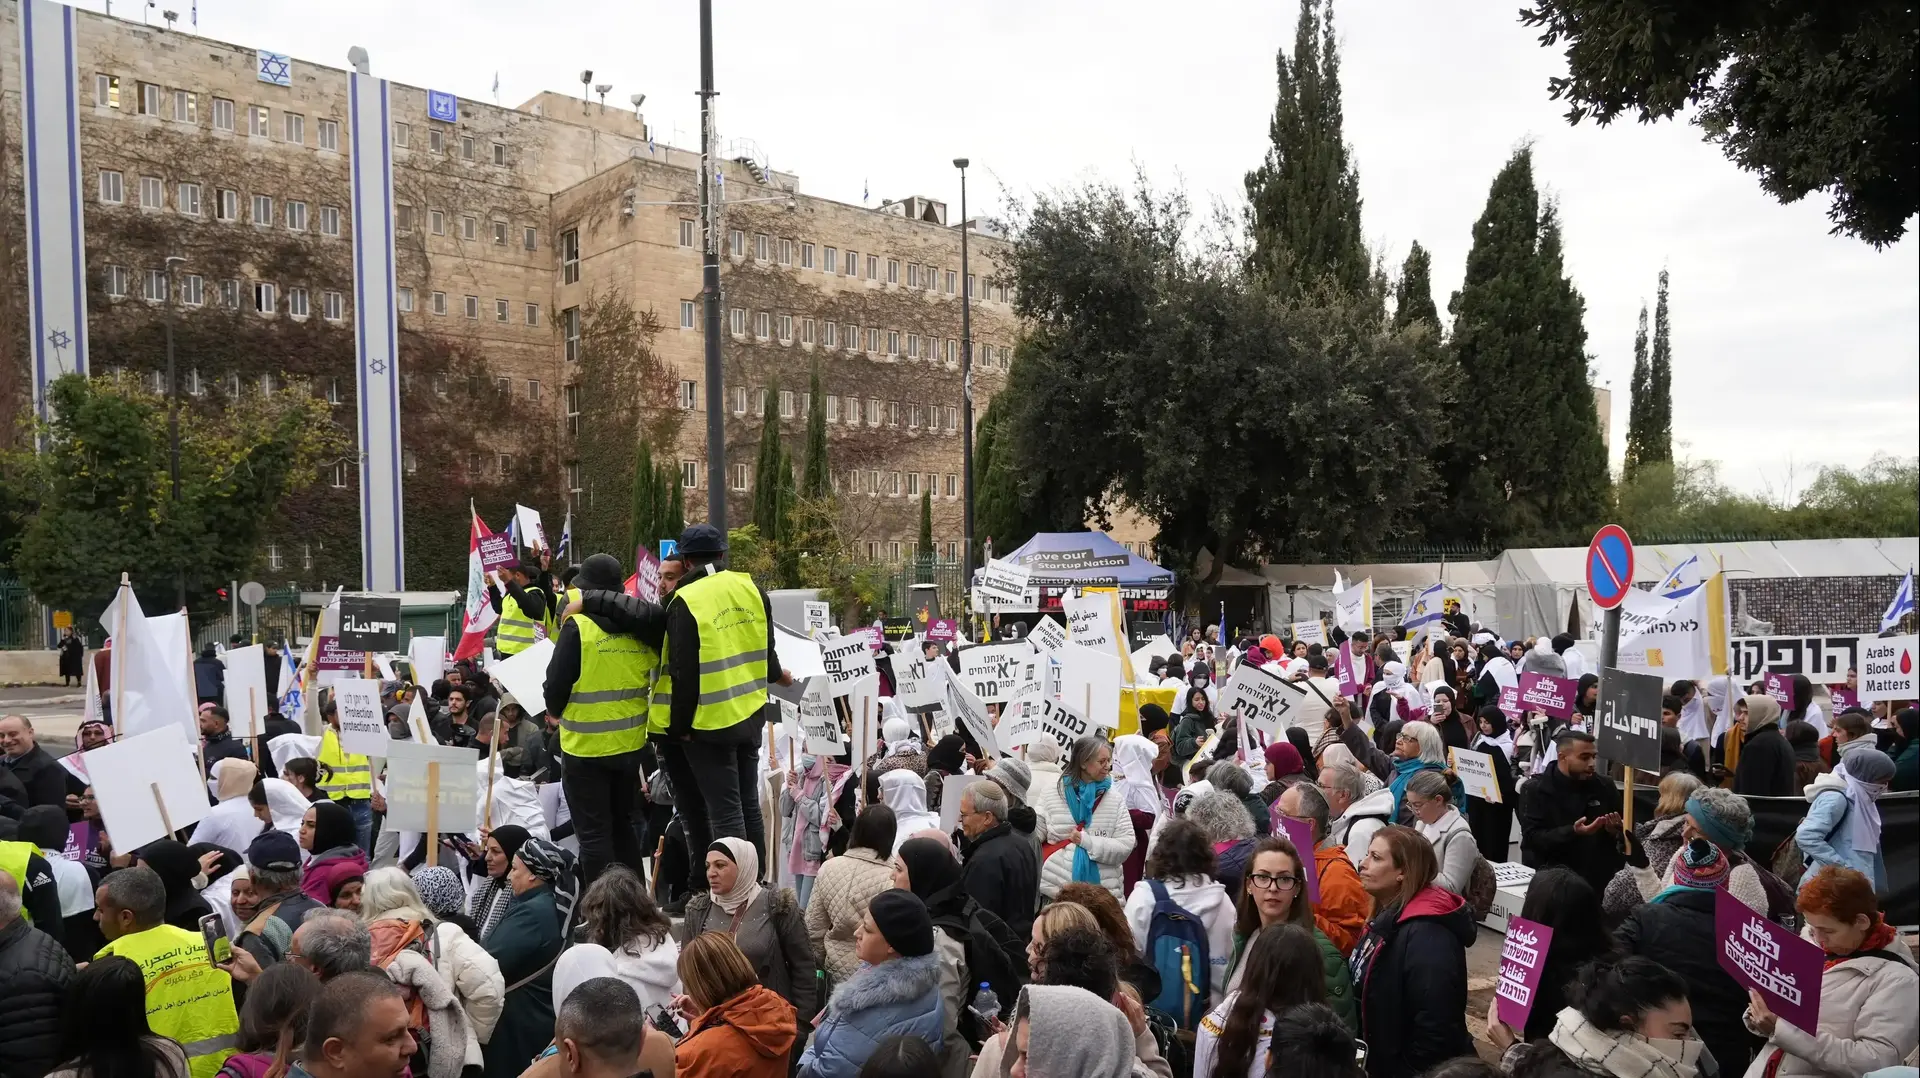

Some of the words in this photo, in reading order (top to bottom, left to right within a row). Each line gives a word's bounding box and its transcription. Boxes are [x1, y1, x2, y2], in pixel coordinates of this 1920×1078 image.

[1062, 552, 1087, 560] our
[1038, 561, 1080, 570] Startup
[1084, 558, 1124, 566] Nation
[1028, 577, 1070, 585] Startup
[1048, 622, 1056, 632] We
[1680, 619, 1698, 632] לא
[1038, 626, 1063, 648] protectio
[1097, 636, 1106, 644] לא
[1041, 636, 1057, 652] NOW.
[824, 642, 864, 662] אזרחות
[1866, 646, 1895, 658] Arabs
[984, 654, 1006, 664] אנחנו
[826, 662, 840, 672] גם
[910, 658, 926, 680] לא
[968, 664, 996, 676] אזרחים
[998, 658, 1020, 679] לא
[1866, 662, 1895, 674] Blood
[833, 664, 870, 684] אכיפה
[998, 680, 1016, 688] מסוג
[1258, 682, 1280, 697] אנחנו
[1866, 680, 1910, 692] Matters
[1238, 682, 1266, 701] אזרחים
[1263, 696, 1290, 716] לא
[1524, 695, 1551, 705] הפשיעה
[344, 706, 374, 718] Protection
[1259, 710, 1276, 722] מסוג
[342, 721, 371, 732] protection
[1054, 708, 1088, 735] כמה
[1746, 927, 1776, 957] ביחד
[184, 944, 206, 956] سان
[1508, 943, 1534, 964] ממשלת
[1728, 930, 1770, 970] الجريمة
[140, 948, 182, 969] الصحراء
[1728, 946, 1770, 988] הפשיעה
[1772, 972, 1796, 986] ضد
[212, 987, 230, 996] فرسان
[1502, 983, 1526, 1002] הורגת
[1774, 980, 1797, 1002] נגד
[177, 1000, 186, 1008] من
[187, 992, 212, 1004] الصحراء
[146, 1004, 162, 1016] المجتم
